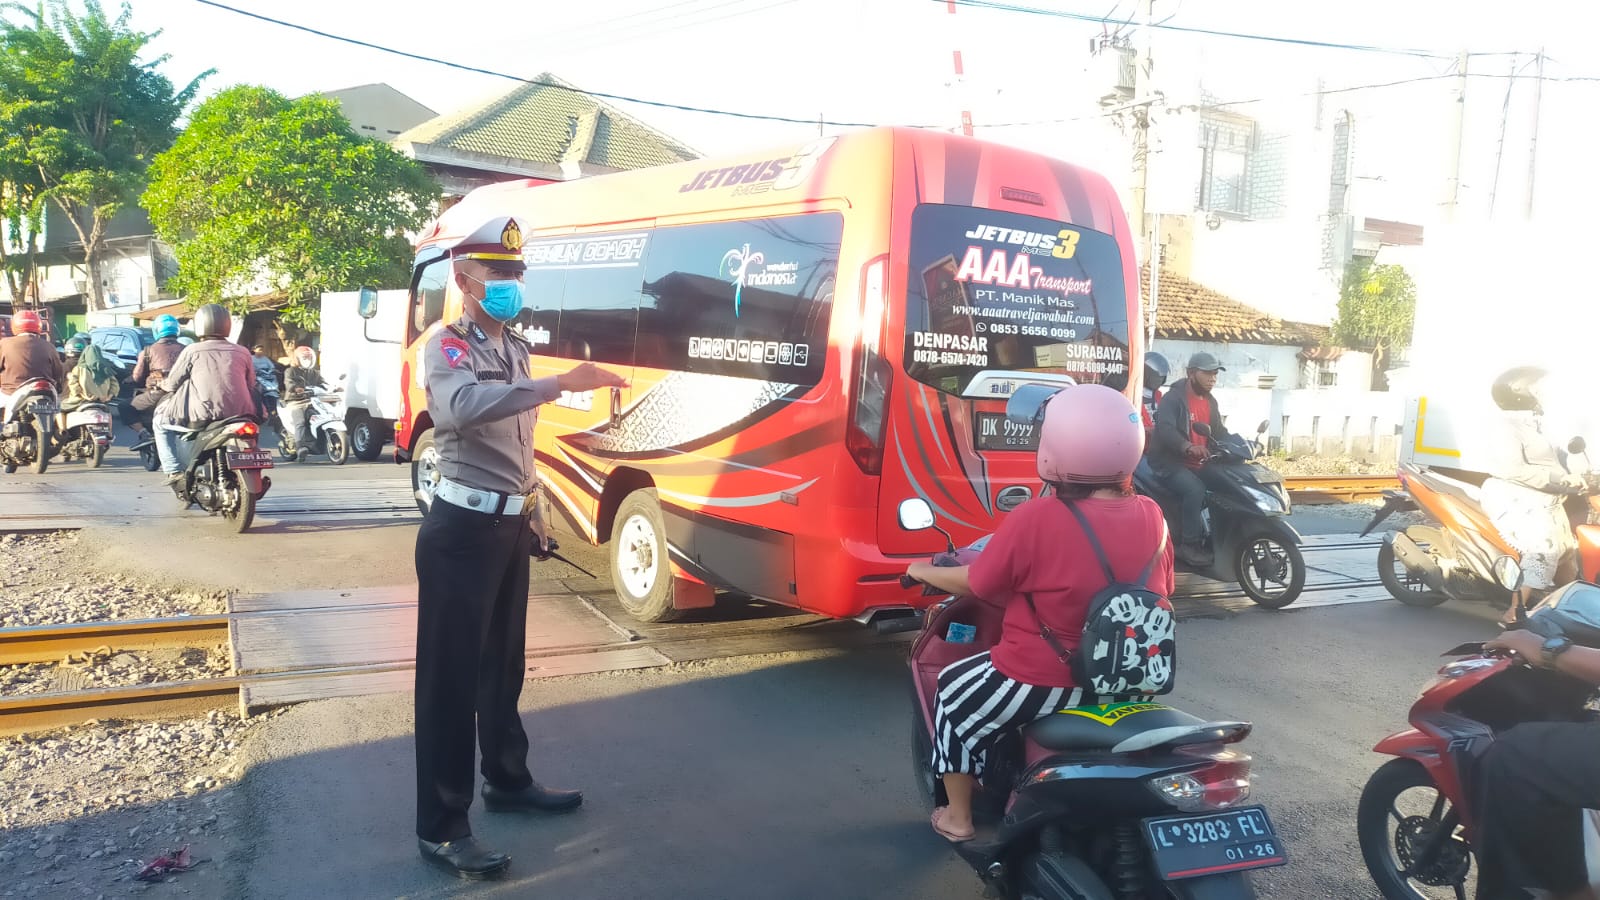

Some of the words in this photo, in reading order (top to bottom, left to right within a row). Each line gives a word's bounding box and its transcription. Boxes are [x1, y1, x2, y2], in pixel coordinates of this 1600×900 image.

[679, 157, 791, 193] JETBUS
[965, 224, 1057, 250] JETBUS
[747, 270, 798, 286] indonesia
[955, 246, 1031, 289] AAA
[1030, 266, 1092, 297] Transport
[975, 289, 999, 302] PT.
[1002, 291, 1045, 305] Manik
[1047, 296, 1075, 308] Mas
[952, 304, 1095, 325] www.aaatraveljawabali.com
[990, 323, 1018, 335] 0853
[1021, 325, 1048, 337] 5656
[1050, 327, 1076, 339] 0099
[913, 331, 988, 352] DENPASAR
[913, 349, 988, 367] 0878-6574-7420
[1066, 343, 1123, 361] SURABAYA
[982, 418, 998, 436] DK
[1446, 738, 1473, 753] FI
[1157, 826, 1174, 847] L
[1182, 819, 1232, 844] 3283
[1237, 814, 1265, 837] FL
